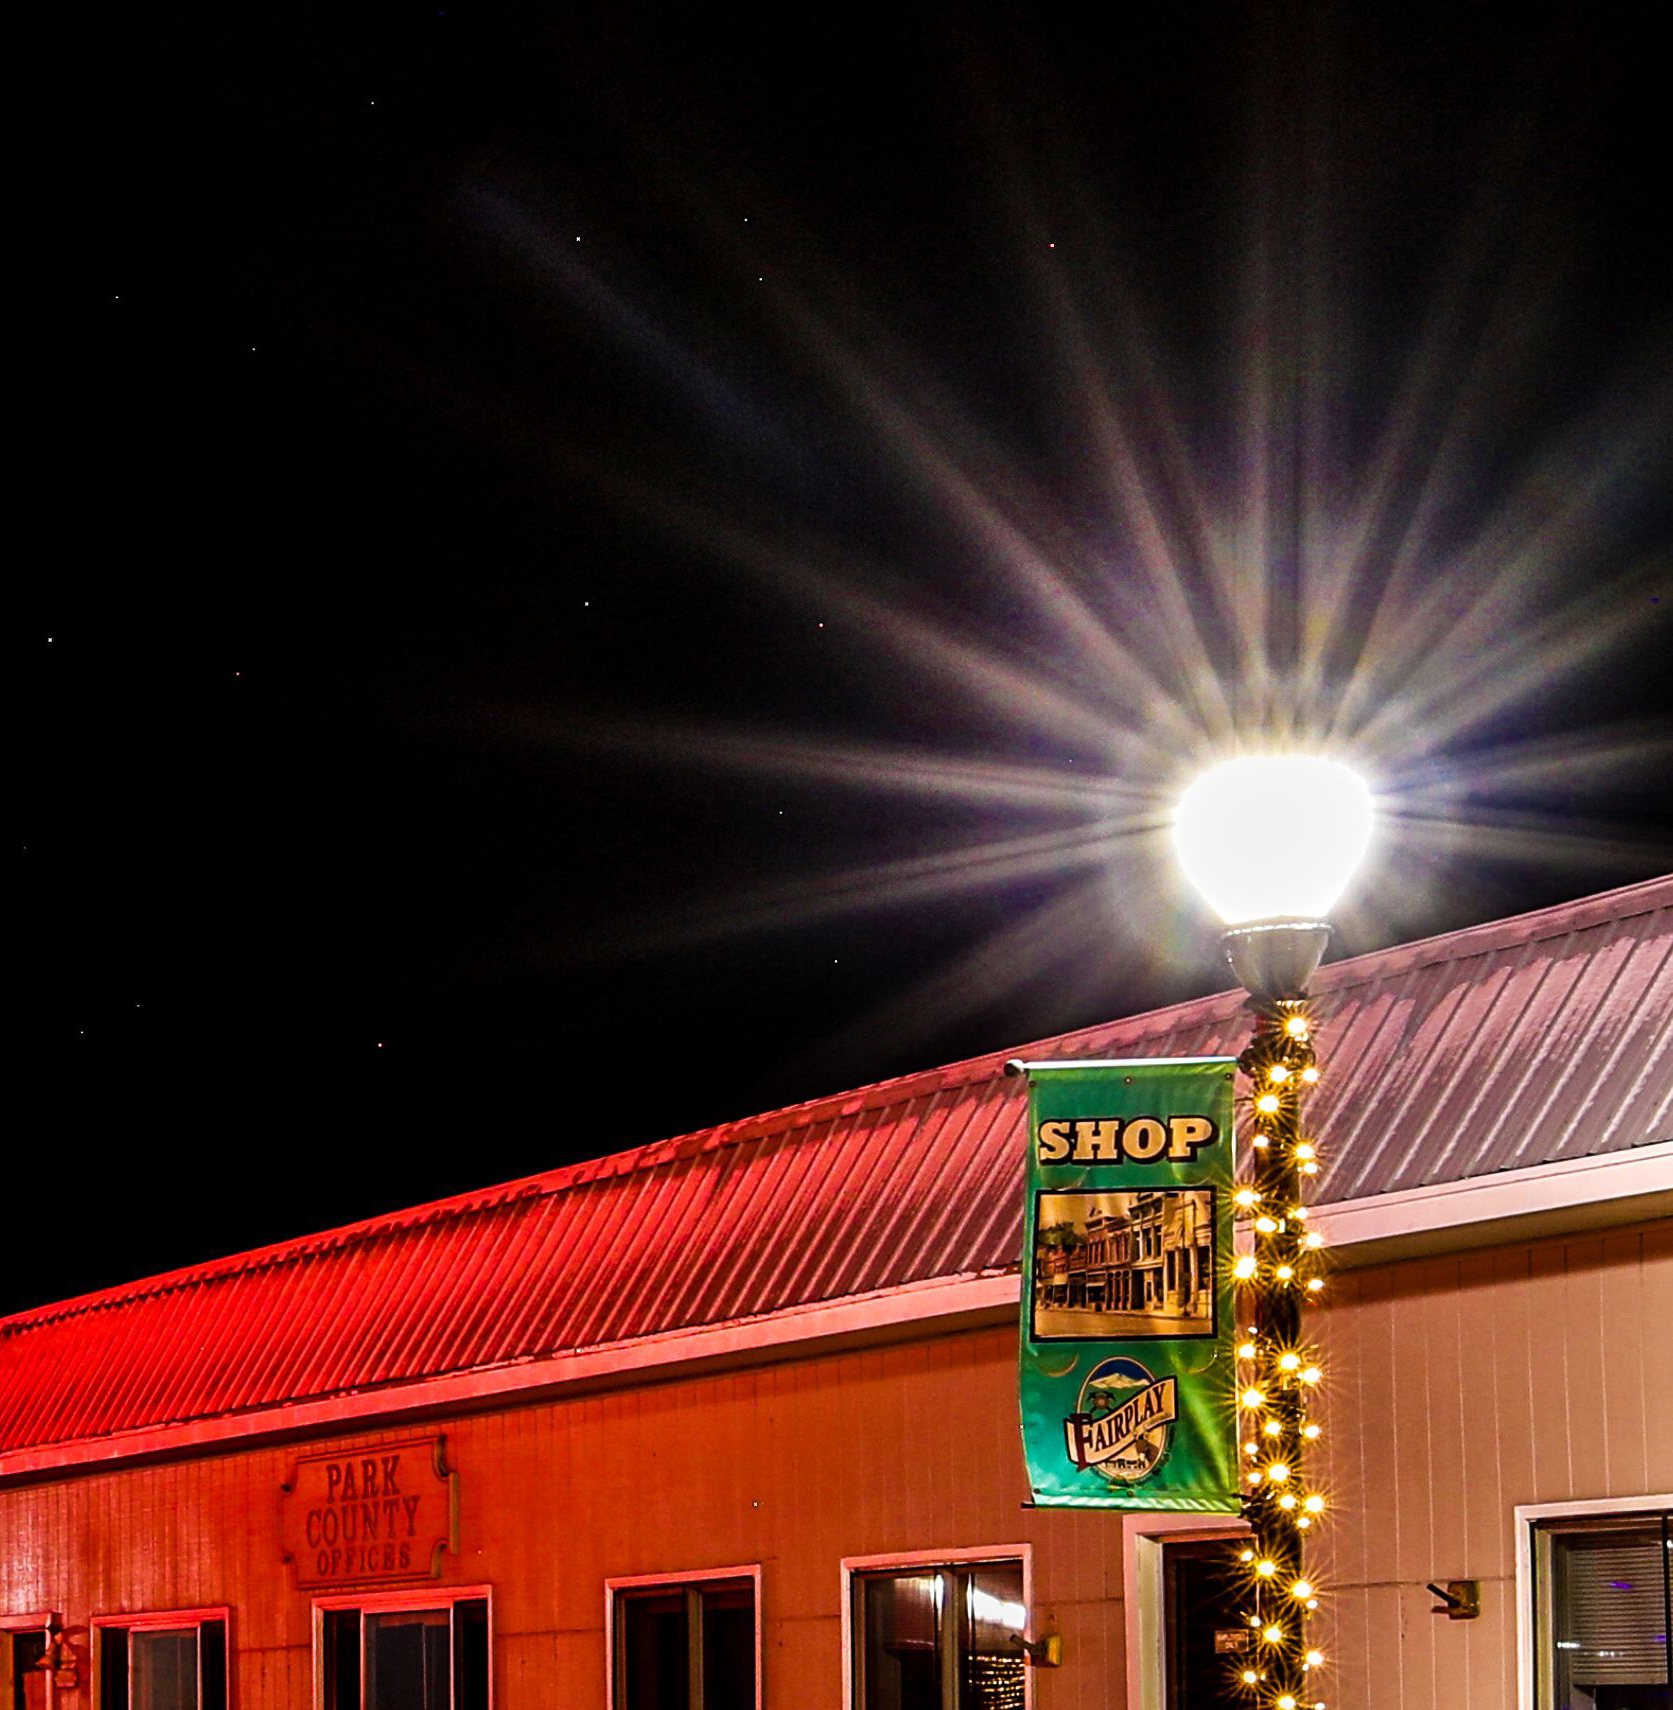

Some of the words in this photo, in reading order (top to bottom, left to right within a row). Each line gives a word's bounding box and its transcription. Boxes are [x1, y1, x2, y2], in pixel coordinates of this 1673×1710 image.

[1039, 1116, 1215, 1165] SHOP
[1069, 1382, 1166, 1472] FAIRPLAY
[326, 1455, 400, 1504] PARK
[306, 1495, 421, 1549] COUNTY
[317, 1541, 411, 1576] OFFICES
